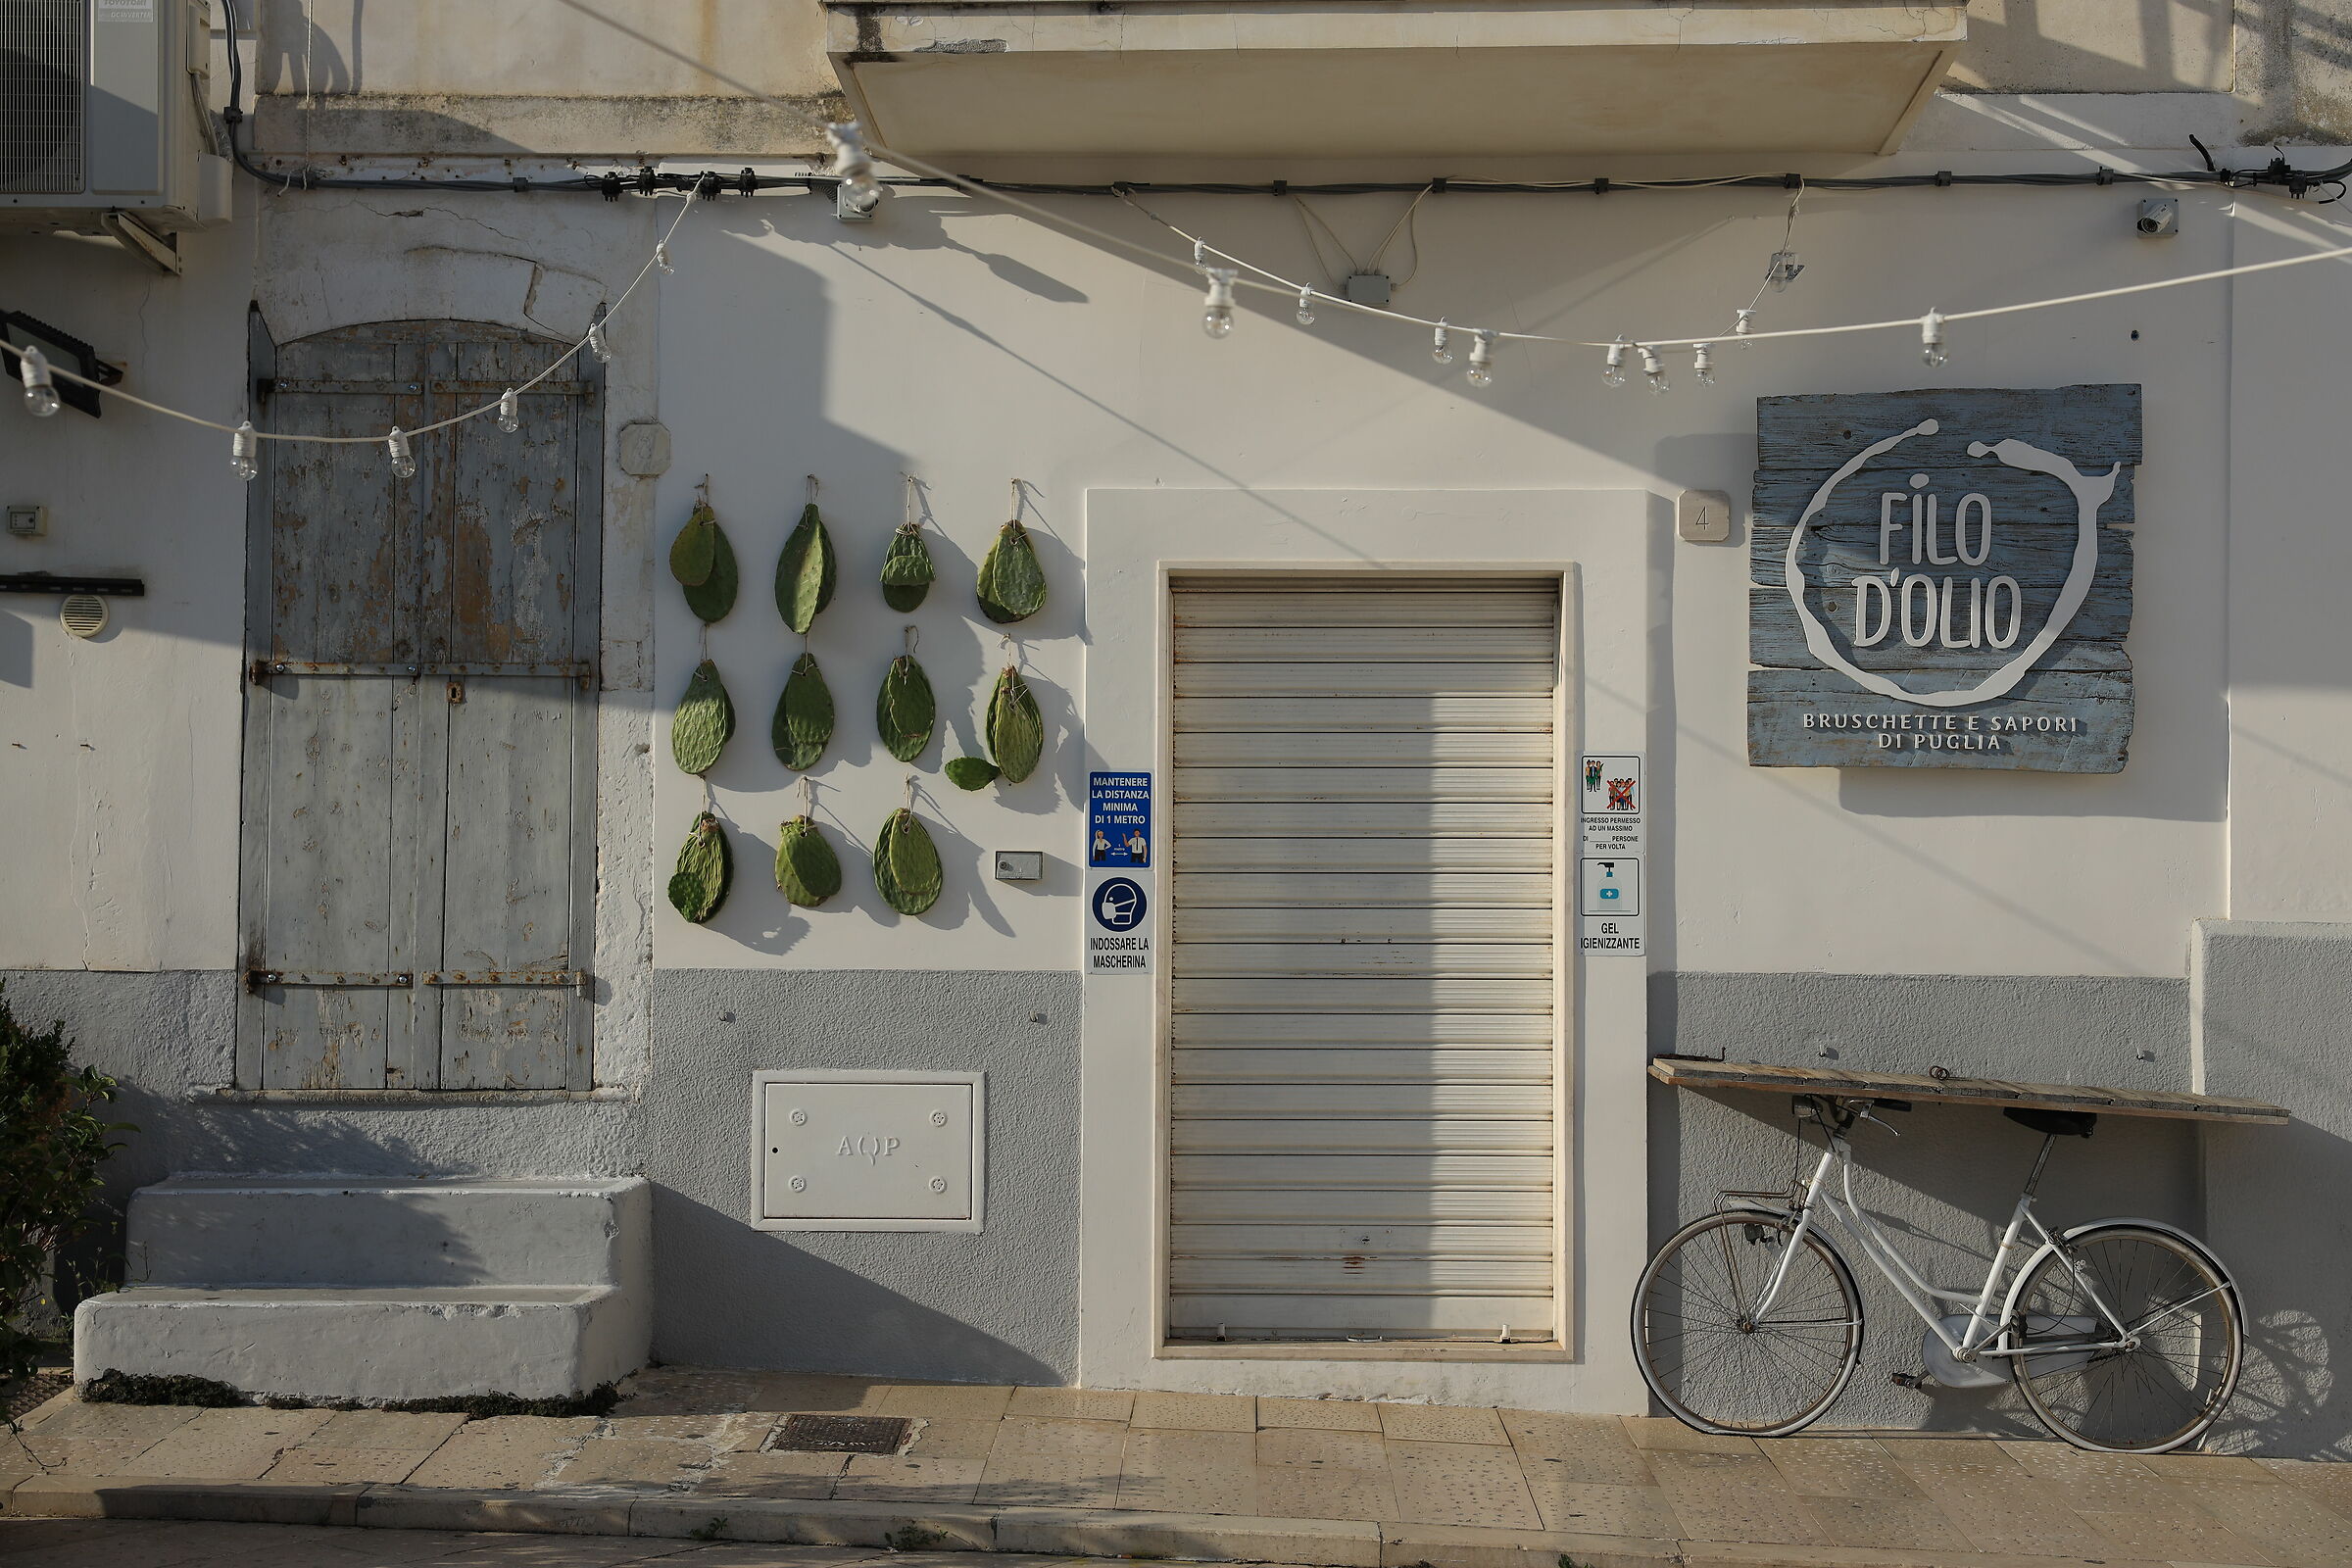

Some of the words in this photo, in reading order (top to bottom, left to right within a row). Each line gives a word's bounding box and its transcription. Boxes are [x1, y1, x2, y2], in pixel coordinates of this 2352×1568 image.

[1695, 506, 1710, 530] 4
[1803, 713, 1958, 730] BRUSCHETTE
[1968, 716, 1980, 731] E
[1990, 716, 2077, 732] SAPORI
[1879, 734, 1902, 749] DI
[1914, 734, 2000, 750] PUGLIA
[1093, 777, 1149, 787] MANTENERE
[1092, 790, 1103, 799] LA
[1104, 790, 1150, 800] DISTANZA
[1102, 803, 1138, 811] MINIMA
[1095, 814, 1104, 824] DI
[1106, 814, 1111, 824] 1
[1113, 814, 1146, 824] METRO
[1600, 922, 1620, 934] GEL
[1090, 937, 1137, 951] INDOSSARE
[1138, 937, 1150, 951] LA
[1580, 937, 1641, 950] IGIENIZZANTE
[1093, 955, 1147, 968] MASCHERINA
[837, 1136, 901, 1166] AQP
